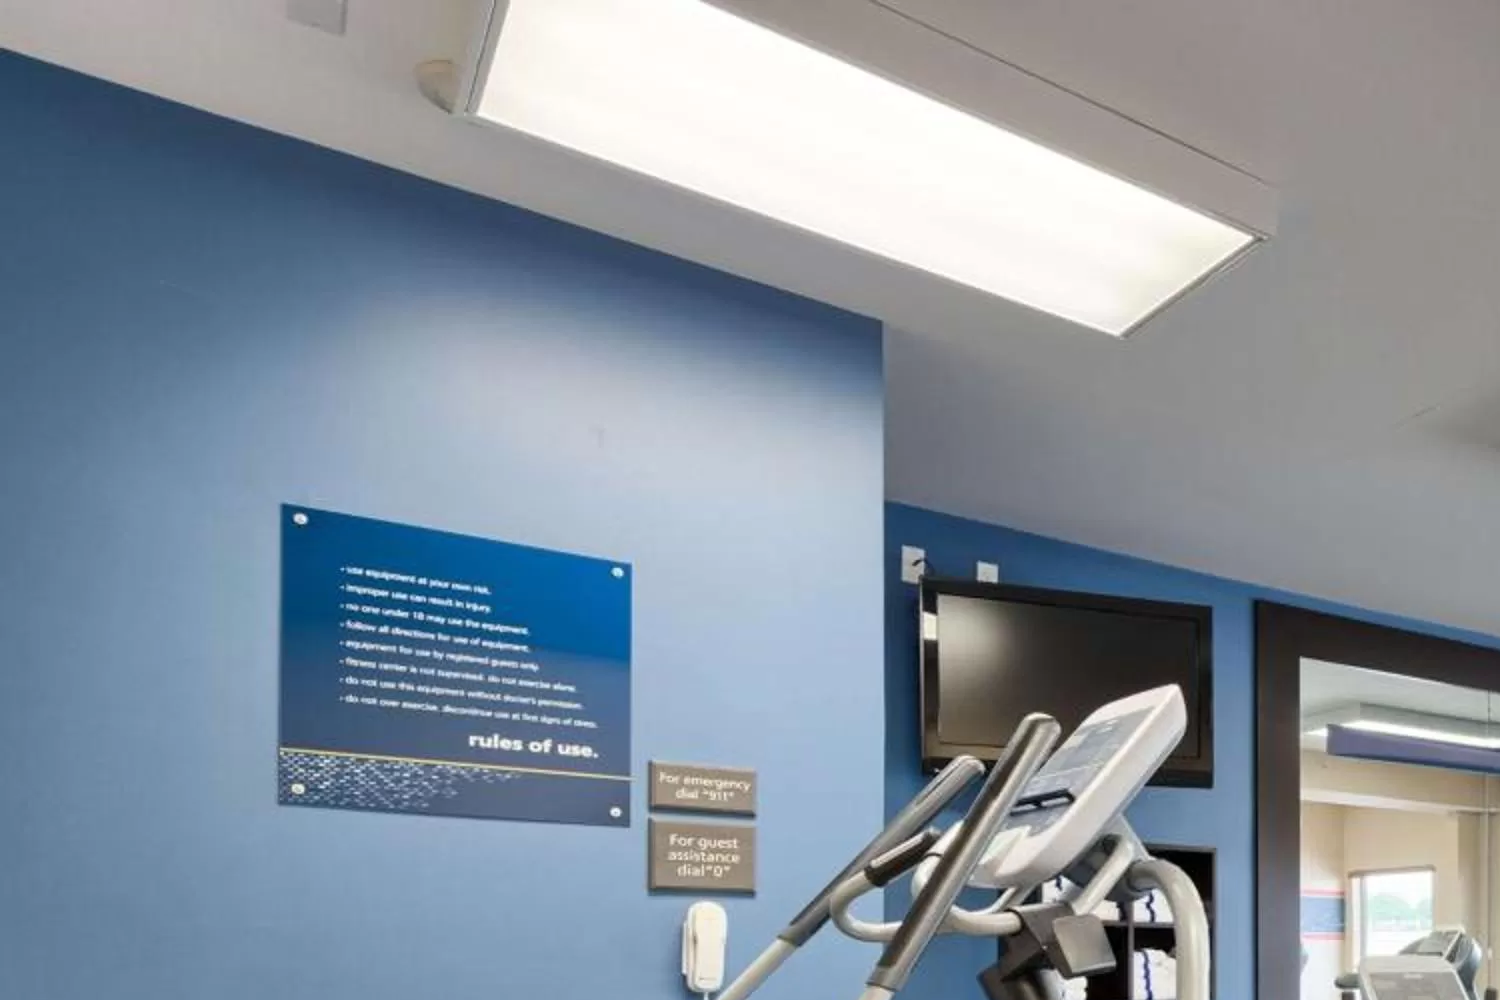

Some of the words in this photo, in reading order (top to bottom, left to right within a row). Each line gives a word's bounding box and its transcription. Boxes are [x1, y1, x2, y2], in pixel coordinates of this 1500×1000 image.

[468, 733, 524, 752] rules
[528, 738, 553, 754] of
[557, 743, 599, 759] use.
[659, 771, 681, 785] For
[683, 775, 752, 793] emergency
[675, 787, 699, 800] dial
[669, 833, 695, 847] For
[697, 838, 739, 851] guest
[667, 849, 741, 865] assistance
